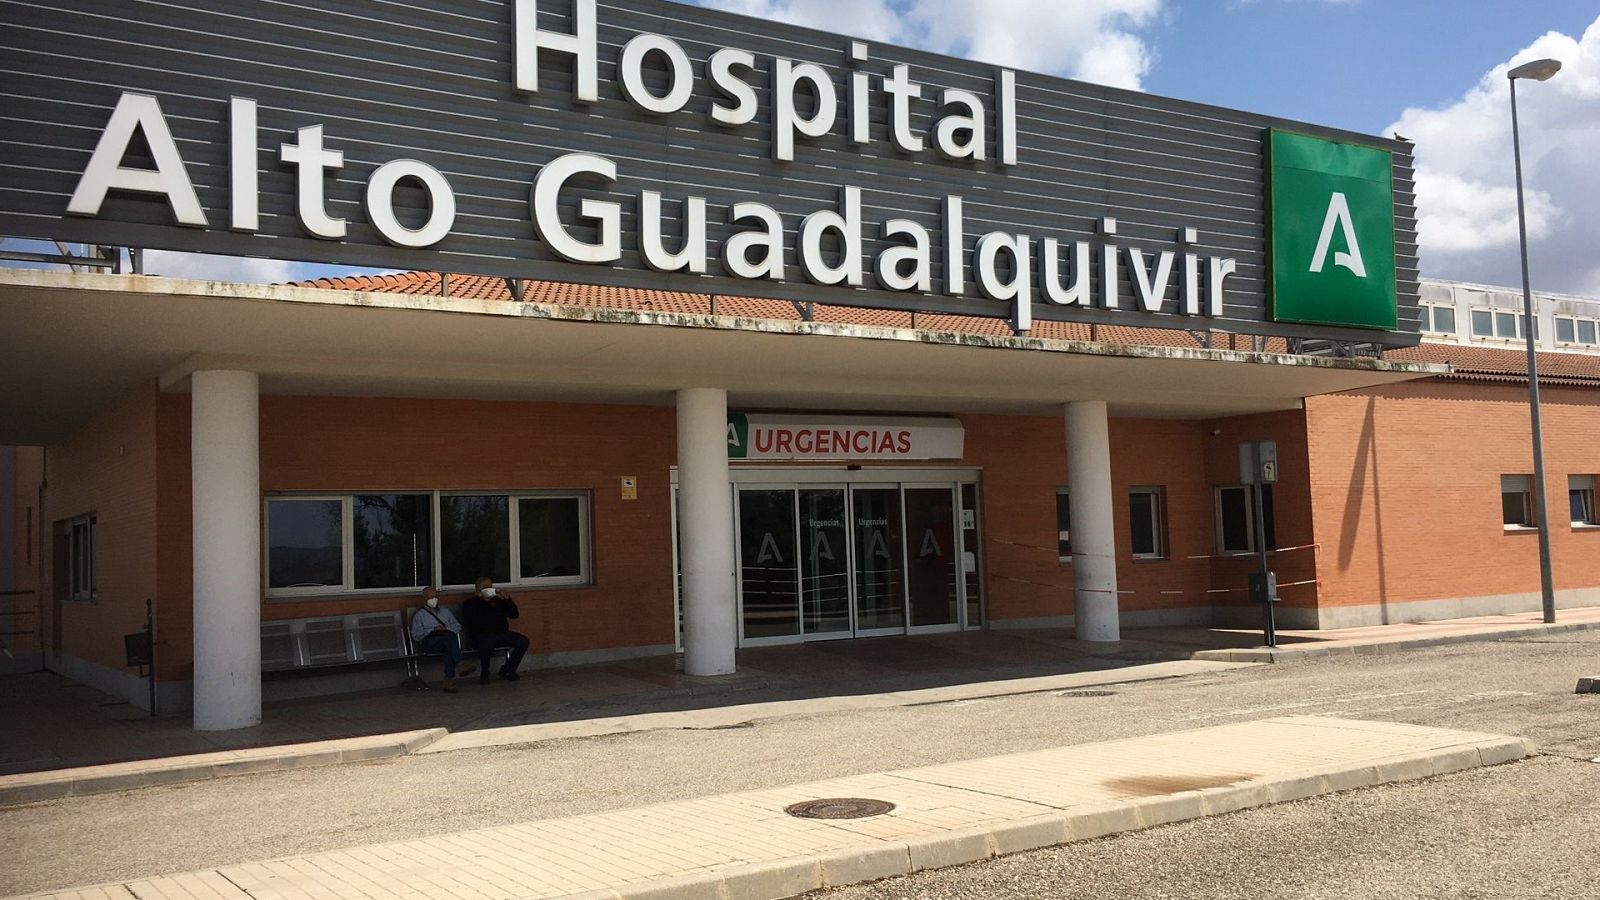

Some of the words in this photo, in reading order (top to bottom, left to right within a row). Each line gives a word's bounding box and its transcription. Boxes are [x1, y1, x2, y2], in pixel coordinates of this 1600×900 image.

[513, 0, 1018, 166] Hospital
[65, 91, 457, 249] Alto
[530, 152, 1236, 331] Guadalquivir
[1309, 192, 1367, 278] A
[755, 429, 912, 453] URGENCIAS
[809, 517, 840, 528] Urgencias
[858, 517, 888, 527] Urgencias
